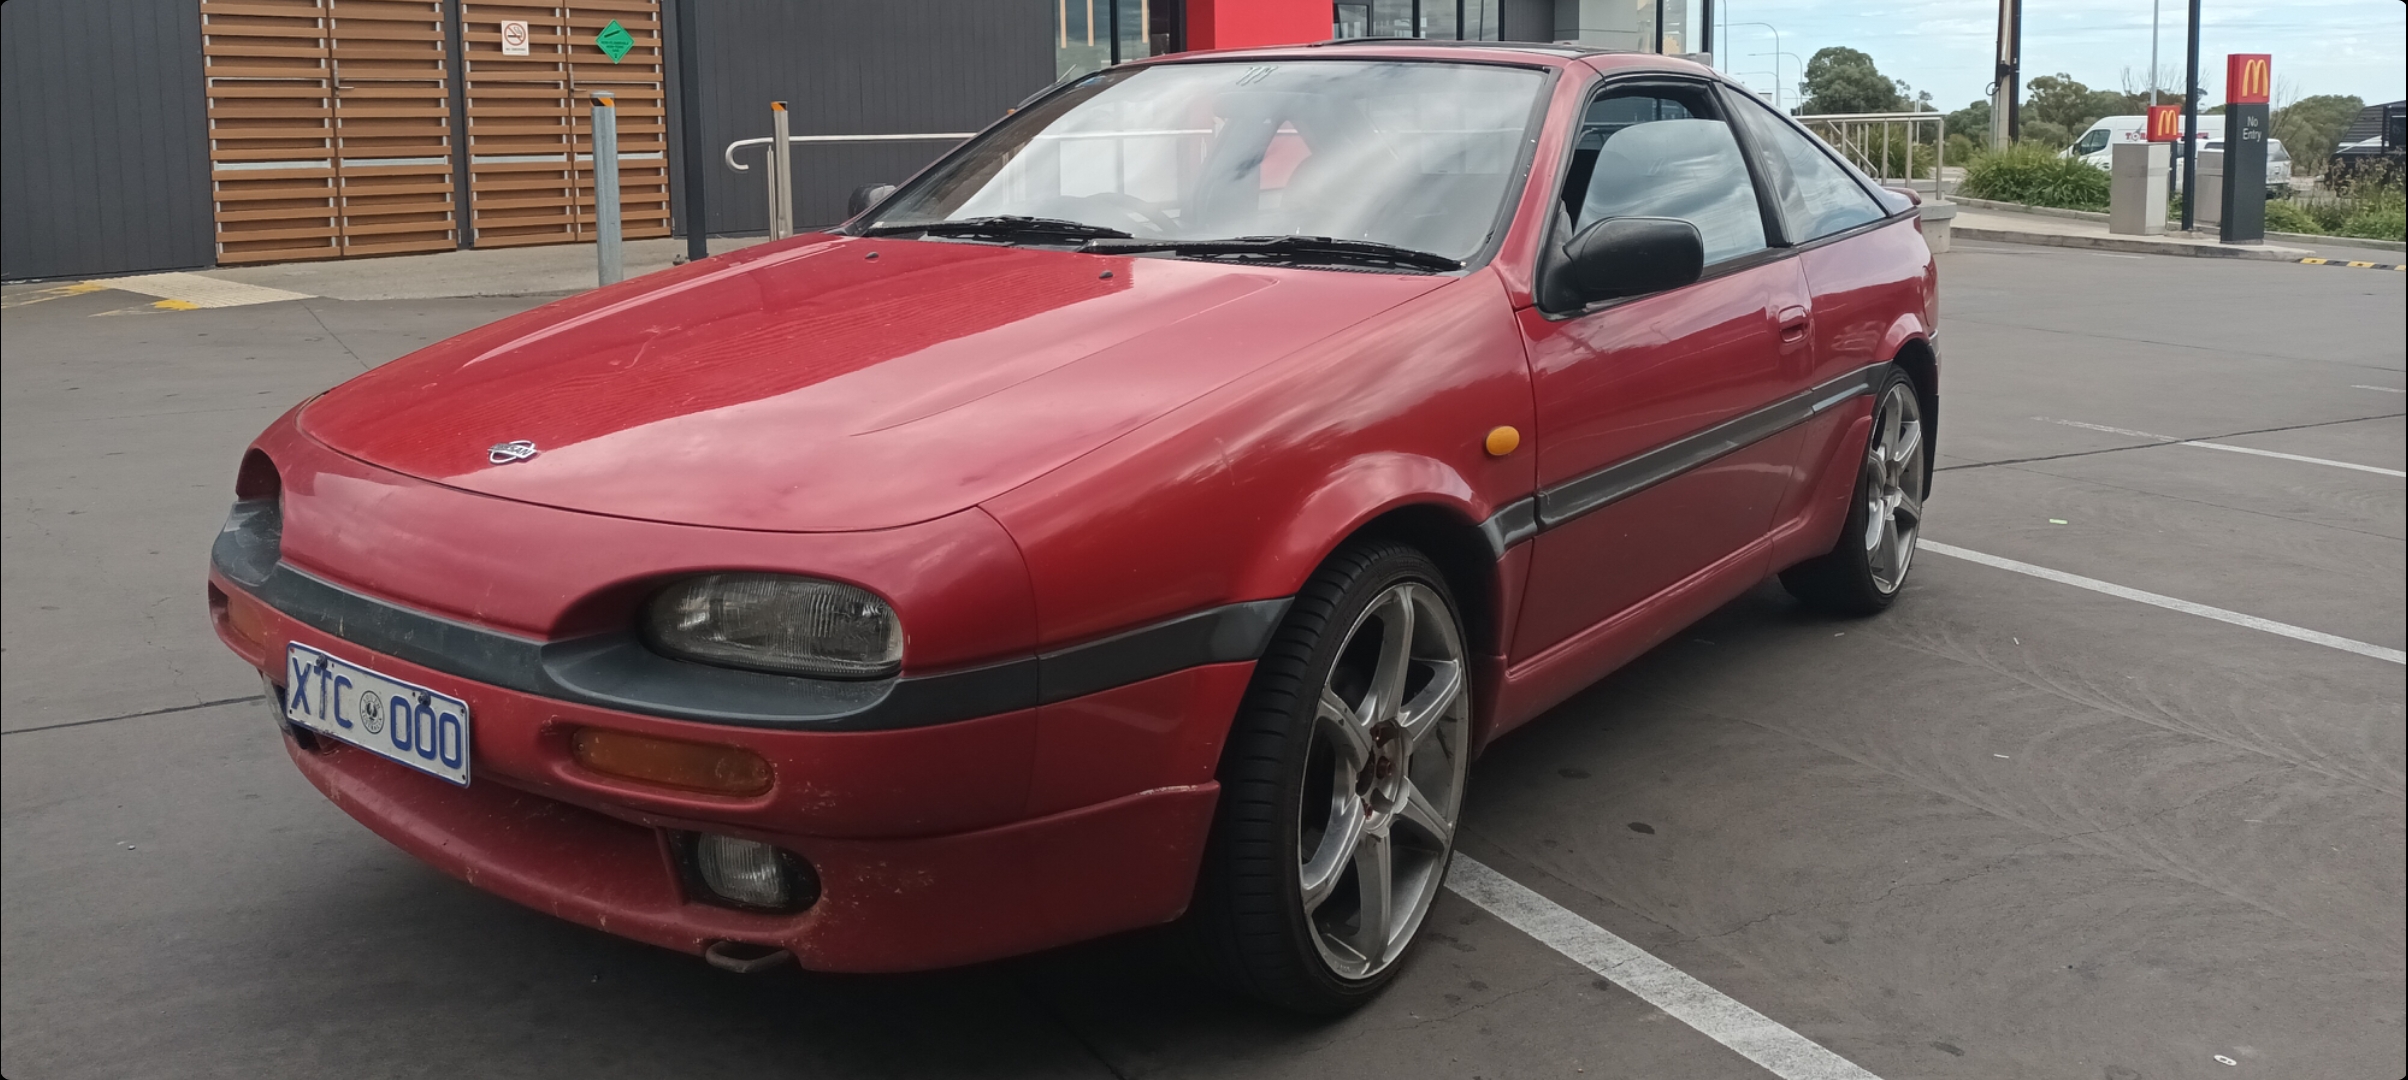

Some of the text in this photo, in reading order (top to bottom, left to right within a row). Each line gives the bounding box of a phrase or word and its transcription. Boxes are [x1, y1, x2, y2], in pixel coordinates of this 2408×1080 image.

[2247, 115, 2259, 127] No
[2242, 127, 2263, 142] Entry
[291, 657, 353, 729] XTC
[390, 695, 462, 769] 000
